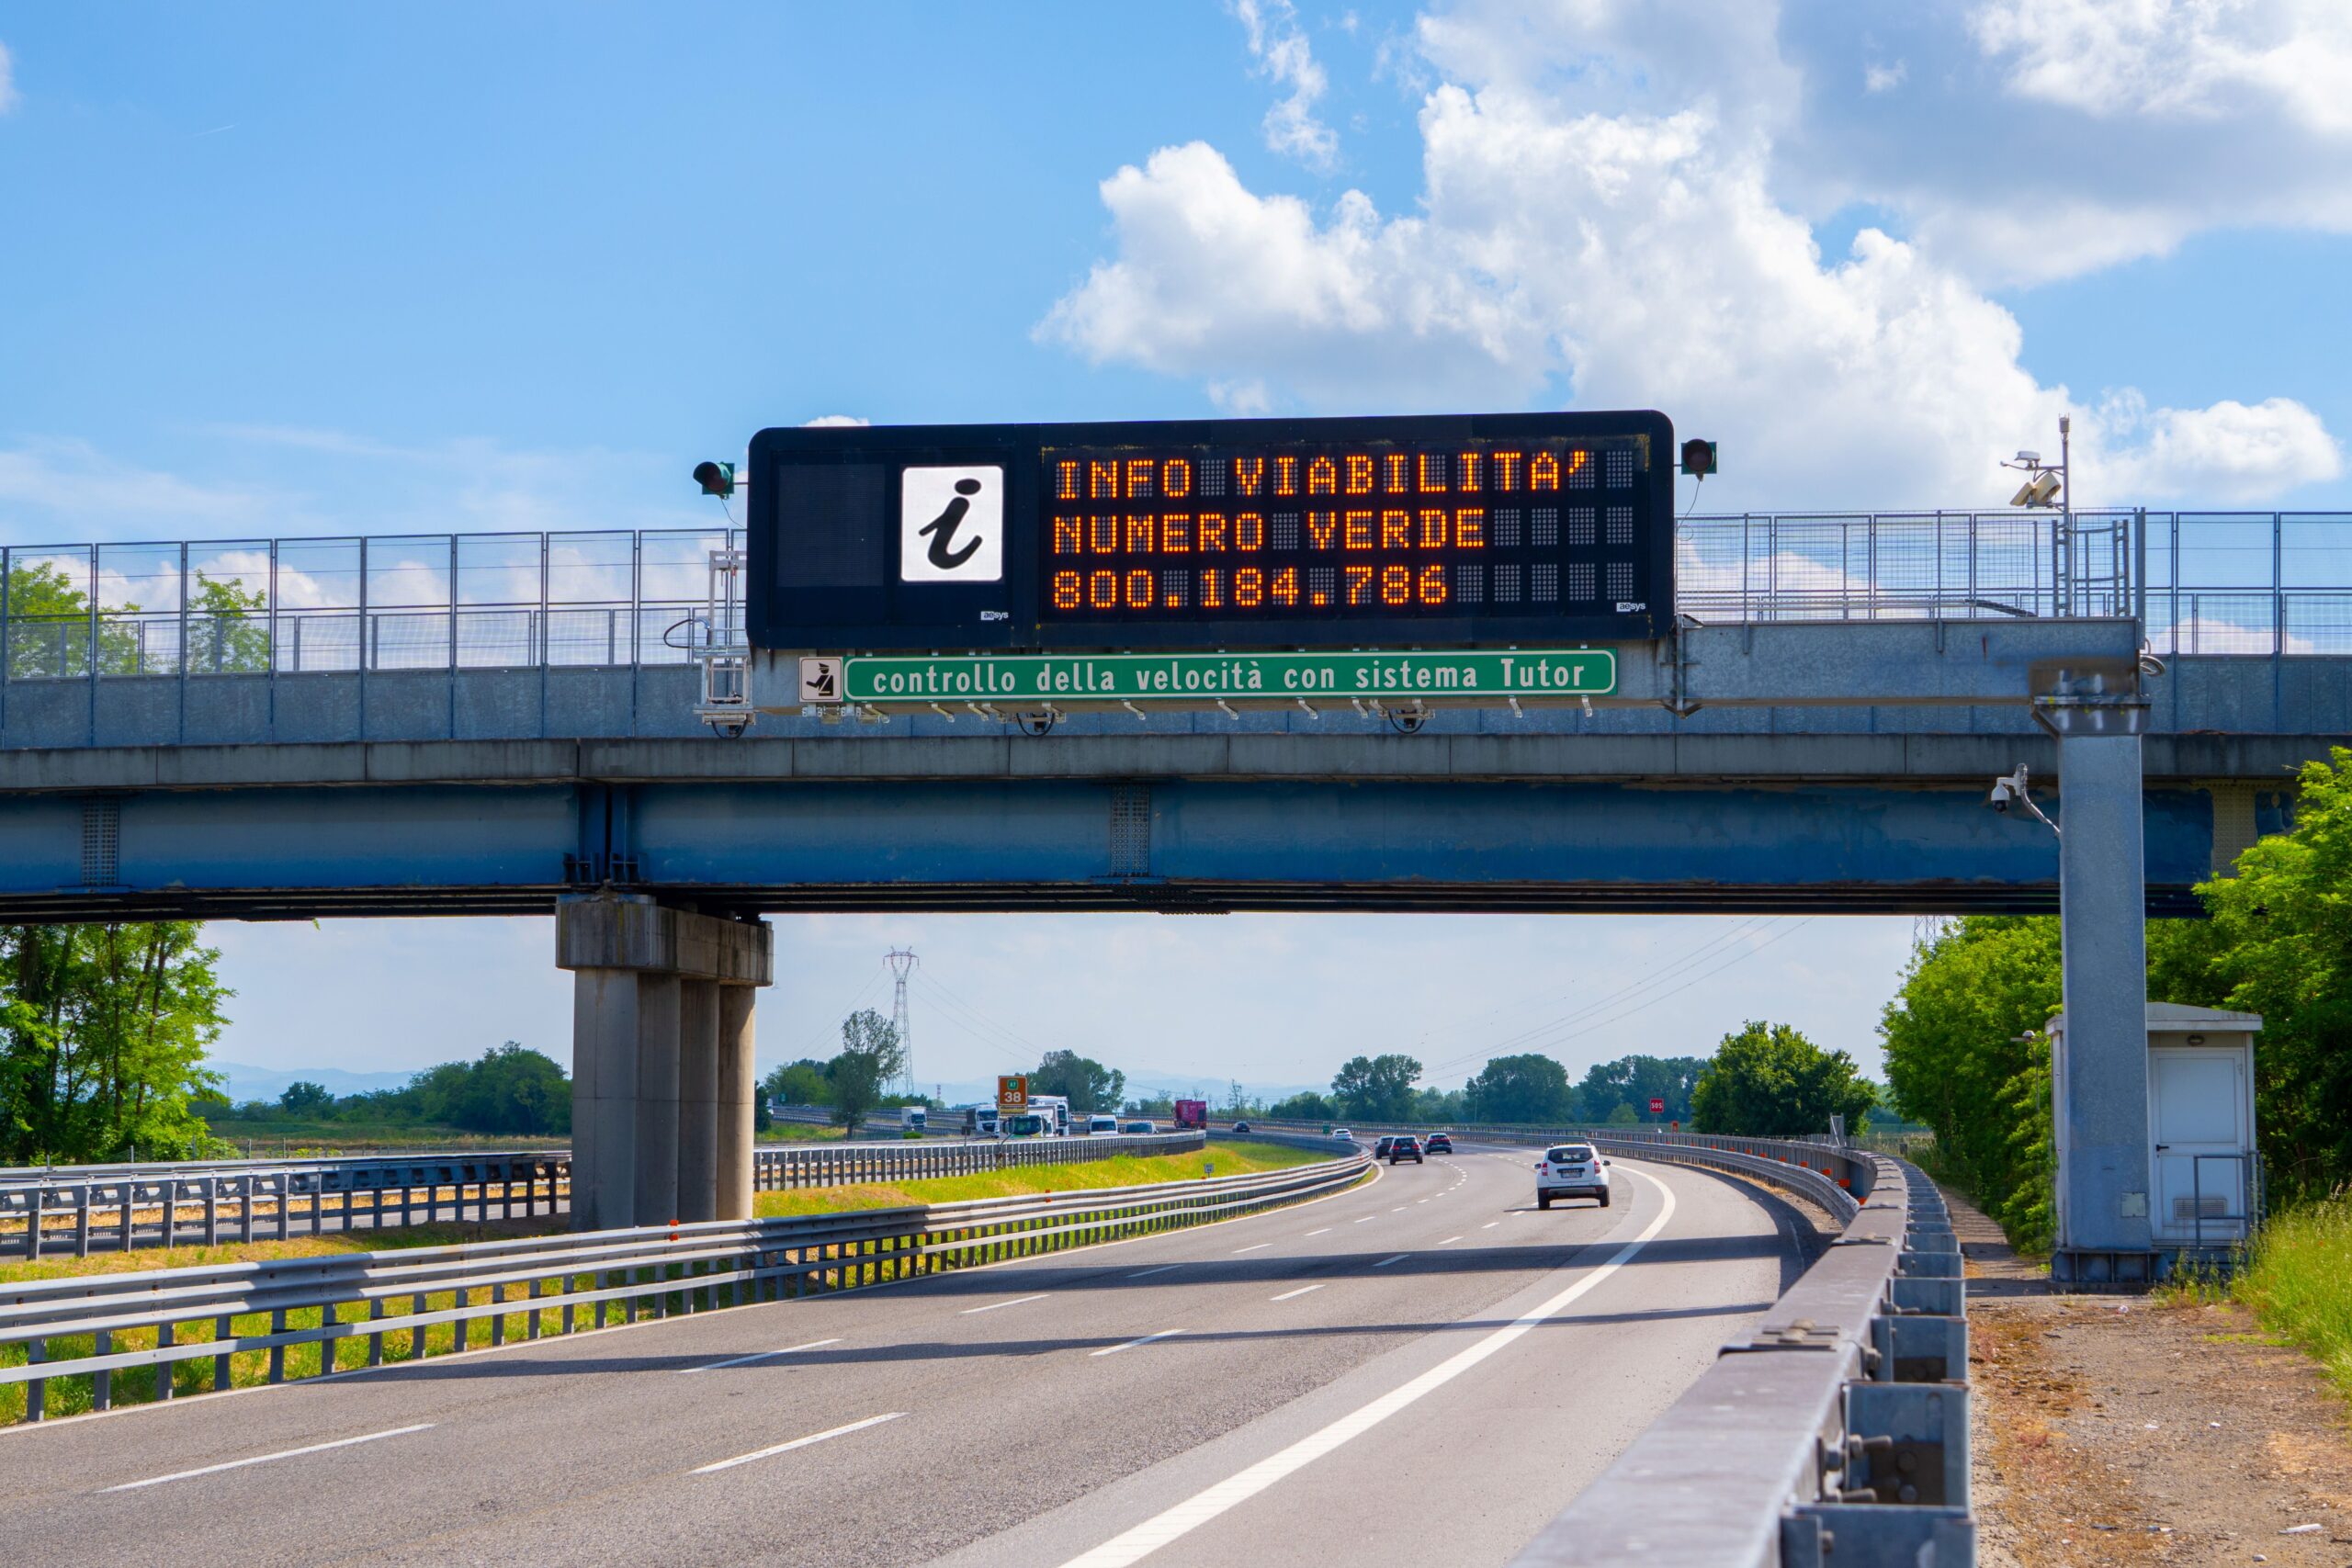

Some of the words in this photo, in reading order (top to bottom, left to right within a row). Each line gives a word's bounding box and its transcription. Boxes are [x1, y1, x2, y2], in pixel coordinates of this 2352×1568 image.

[1061, 460, 1189, 499] INFO
[1056, 513, 1261, 553] NUMERO
[1309, 509, 1483, 549] VERDE
[1055, 566, 1446, 608] 800.184.786
[873, 663, 1015, 693] controllo
[1036, 663, 1114, 692] della
[1136, 661, 1262, 690] velocità
[1283, 666, 1335, 689] con
[1356, 660, 1476, 688] sistema
[1500, 658, 1585, 687] Tutor
[1004, 1092, 1021, 1102] 38
